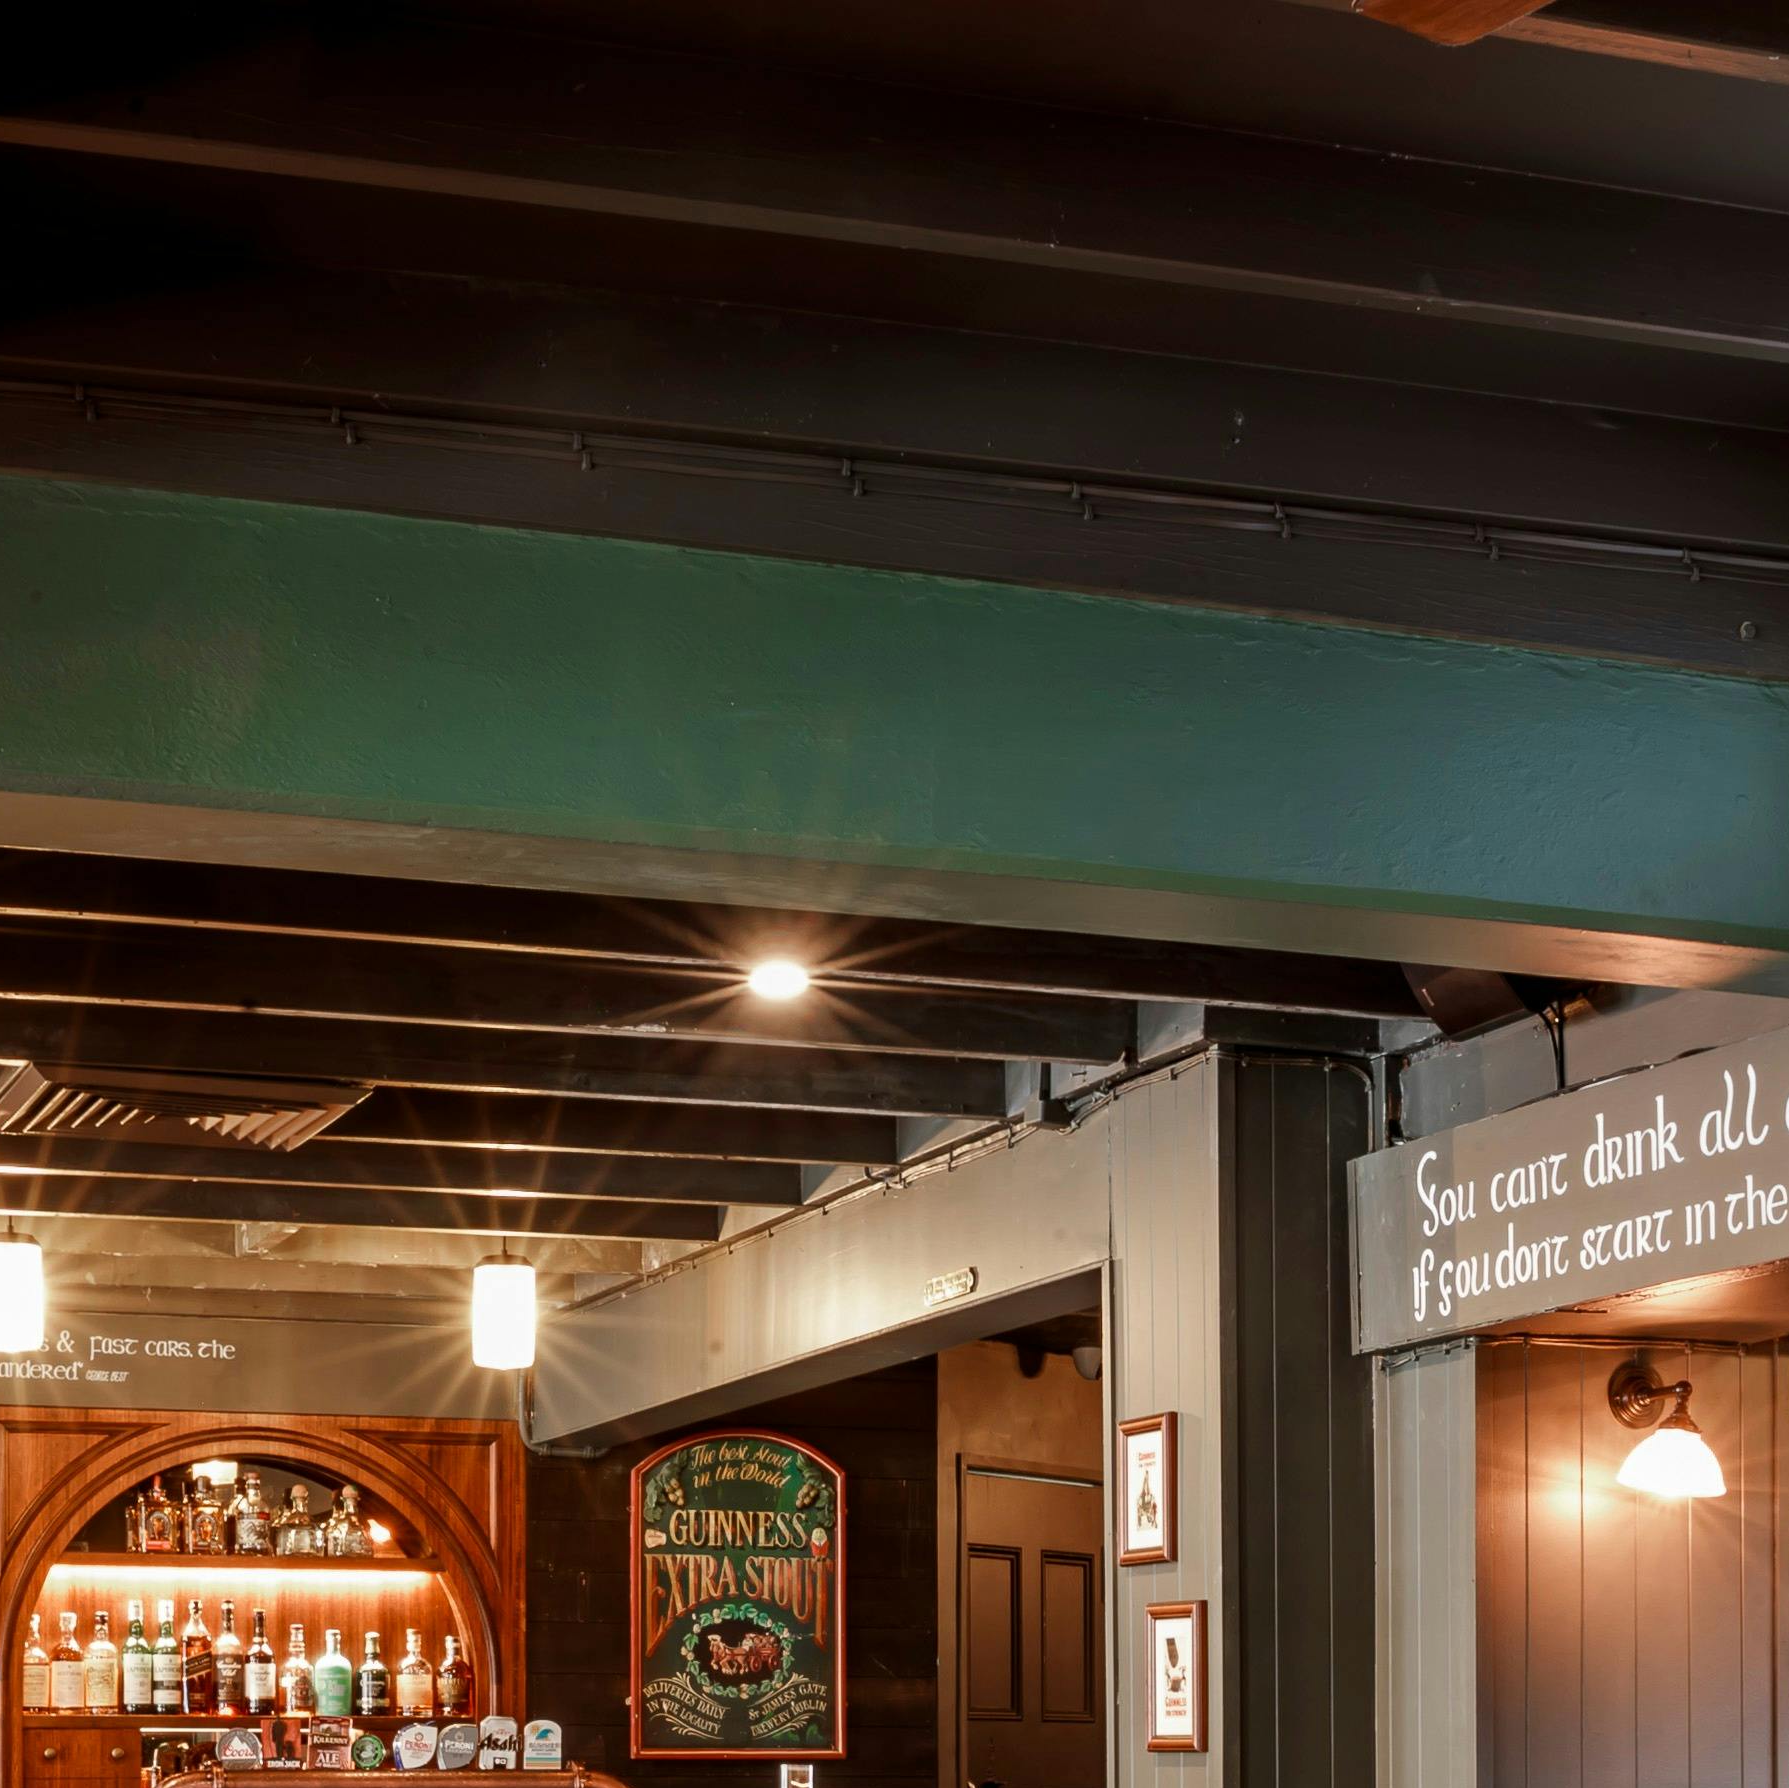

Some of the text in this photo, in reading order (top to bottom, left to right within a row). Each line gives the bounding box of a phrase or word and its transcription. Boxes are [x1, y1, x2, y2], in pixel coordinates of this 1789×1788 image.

[1416, 1150, 1477, 1238] You
[1489, 1152, 1568, 1214] can't
[1583, 1094, 1685, 1189] drink
[1699, 1063, 1770, 1158] all
[1412, 1248, 1435, 1323] If
[1438, 1259, 1491, 1317] you
[1494, 1222, 1569, 1290] don't
[1579, 1208, 1673, 1271] start
[1685, 1199, 1716, 1246] in
[1724, 1174, 1789, 1235] the
[55, 1329, 75, 1353] &
[89, 1335, 139, 1361] fast
[197, 1338, 236, 1361] the
[690, 1441, 793, 1471] The best stout
[692, 1462, 791, 1489] in the World
[668, 1508, 807, 1549] GUINNESS
[644, 1553, 834, 1658] EXTRA STOUT
[642, 1681, 727, 1721] DELIVERIES DAILY
[798, 1683, 828, 1698] GATE
[646, 1699, 660, 1714] IN
[679, 1708, 722, 1736] LOCALITY
[750, 1700, 828, 1738] BREWERY DUBLIN
[223, 1745, 257, 1758] Coors
[312, 1734, 349, 1745] KILKENNY
[404, 1739, 433, 1750] PERONI
[444, 1739, 475, 1750] PERONI
[477, 1733, 524, 1753] Asahi
[285, 1760, 302, 1769] JACK
[315, 1751, 340, 1765] ALE
